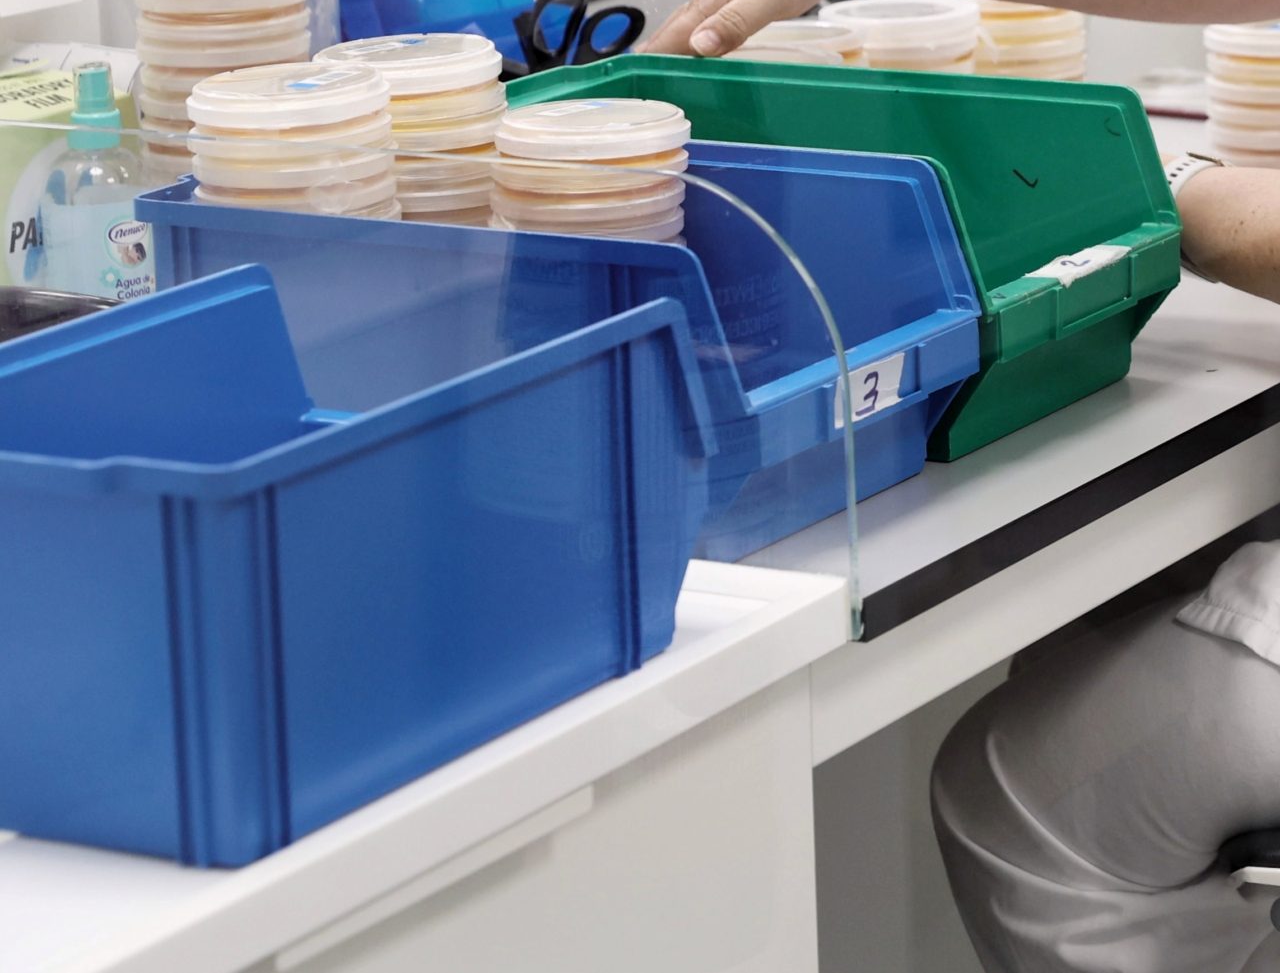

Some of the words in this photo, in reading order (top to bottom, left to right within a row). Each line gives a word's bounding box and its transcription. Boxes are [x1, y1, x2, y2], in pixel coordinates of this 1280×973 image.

[9, 217, 44, 253] PA
[116, 276, 141, 288] Agua
[855, 370, 880, 417] 3
